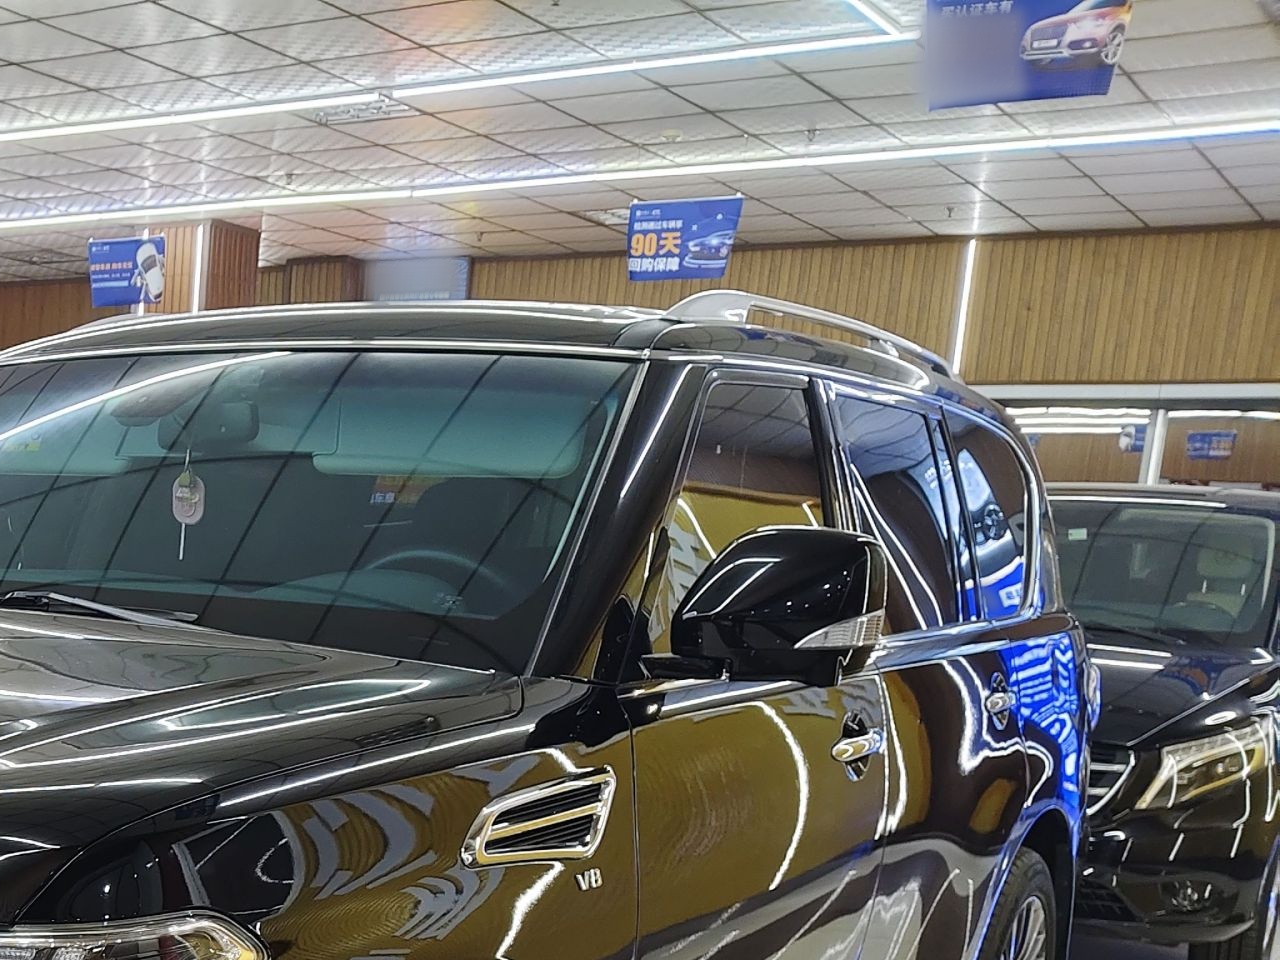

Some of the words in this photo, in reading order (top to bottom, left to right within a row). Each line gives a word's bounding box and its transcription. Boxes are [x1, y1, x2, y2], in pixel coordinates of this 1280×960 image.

[630, 231, 682, 257] 90天
[628, 256, 680, 272] 回购保障
[575, 867, 603, 891] V8
